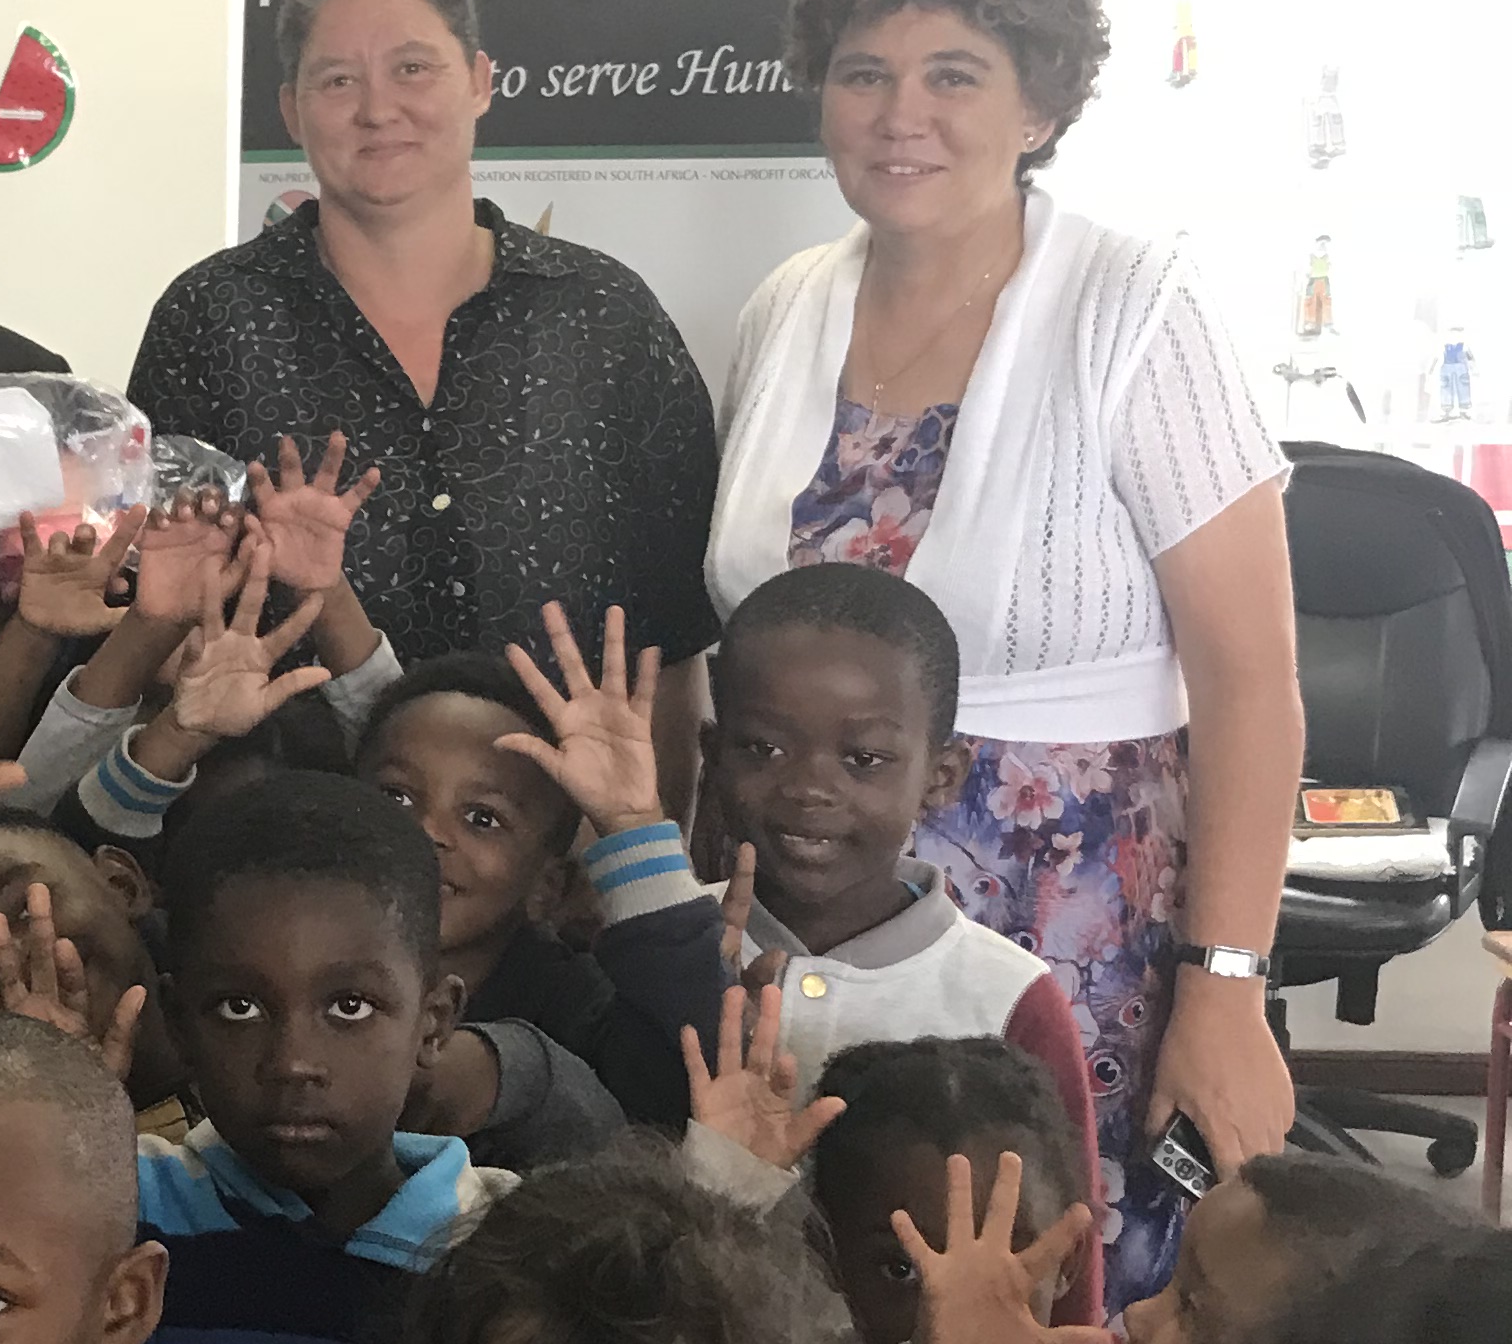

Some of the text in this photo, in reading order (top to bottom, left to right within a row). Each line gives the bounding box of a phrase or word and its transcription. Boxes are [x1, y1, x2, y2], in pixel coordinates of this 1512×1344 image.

[540, 60, 660, 98] serve
[595, 170, 607, 181] IN
[611, 169, 653, 181] SOUTH
[656, 169, 700, 181] AFRICA
[710, 168, 785, 180] NON-PROFIT
